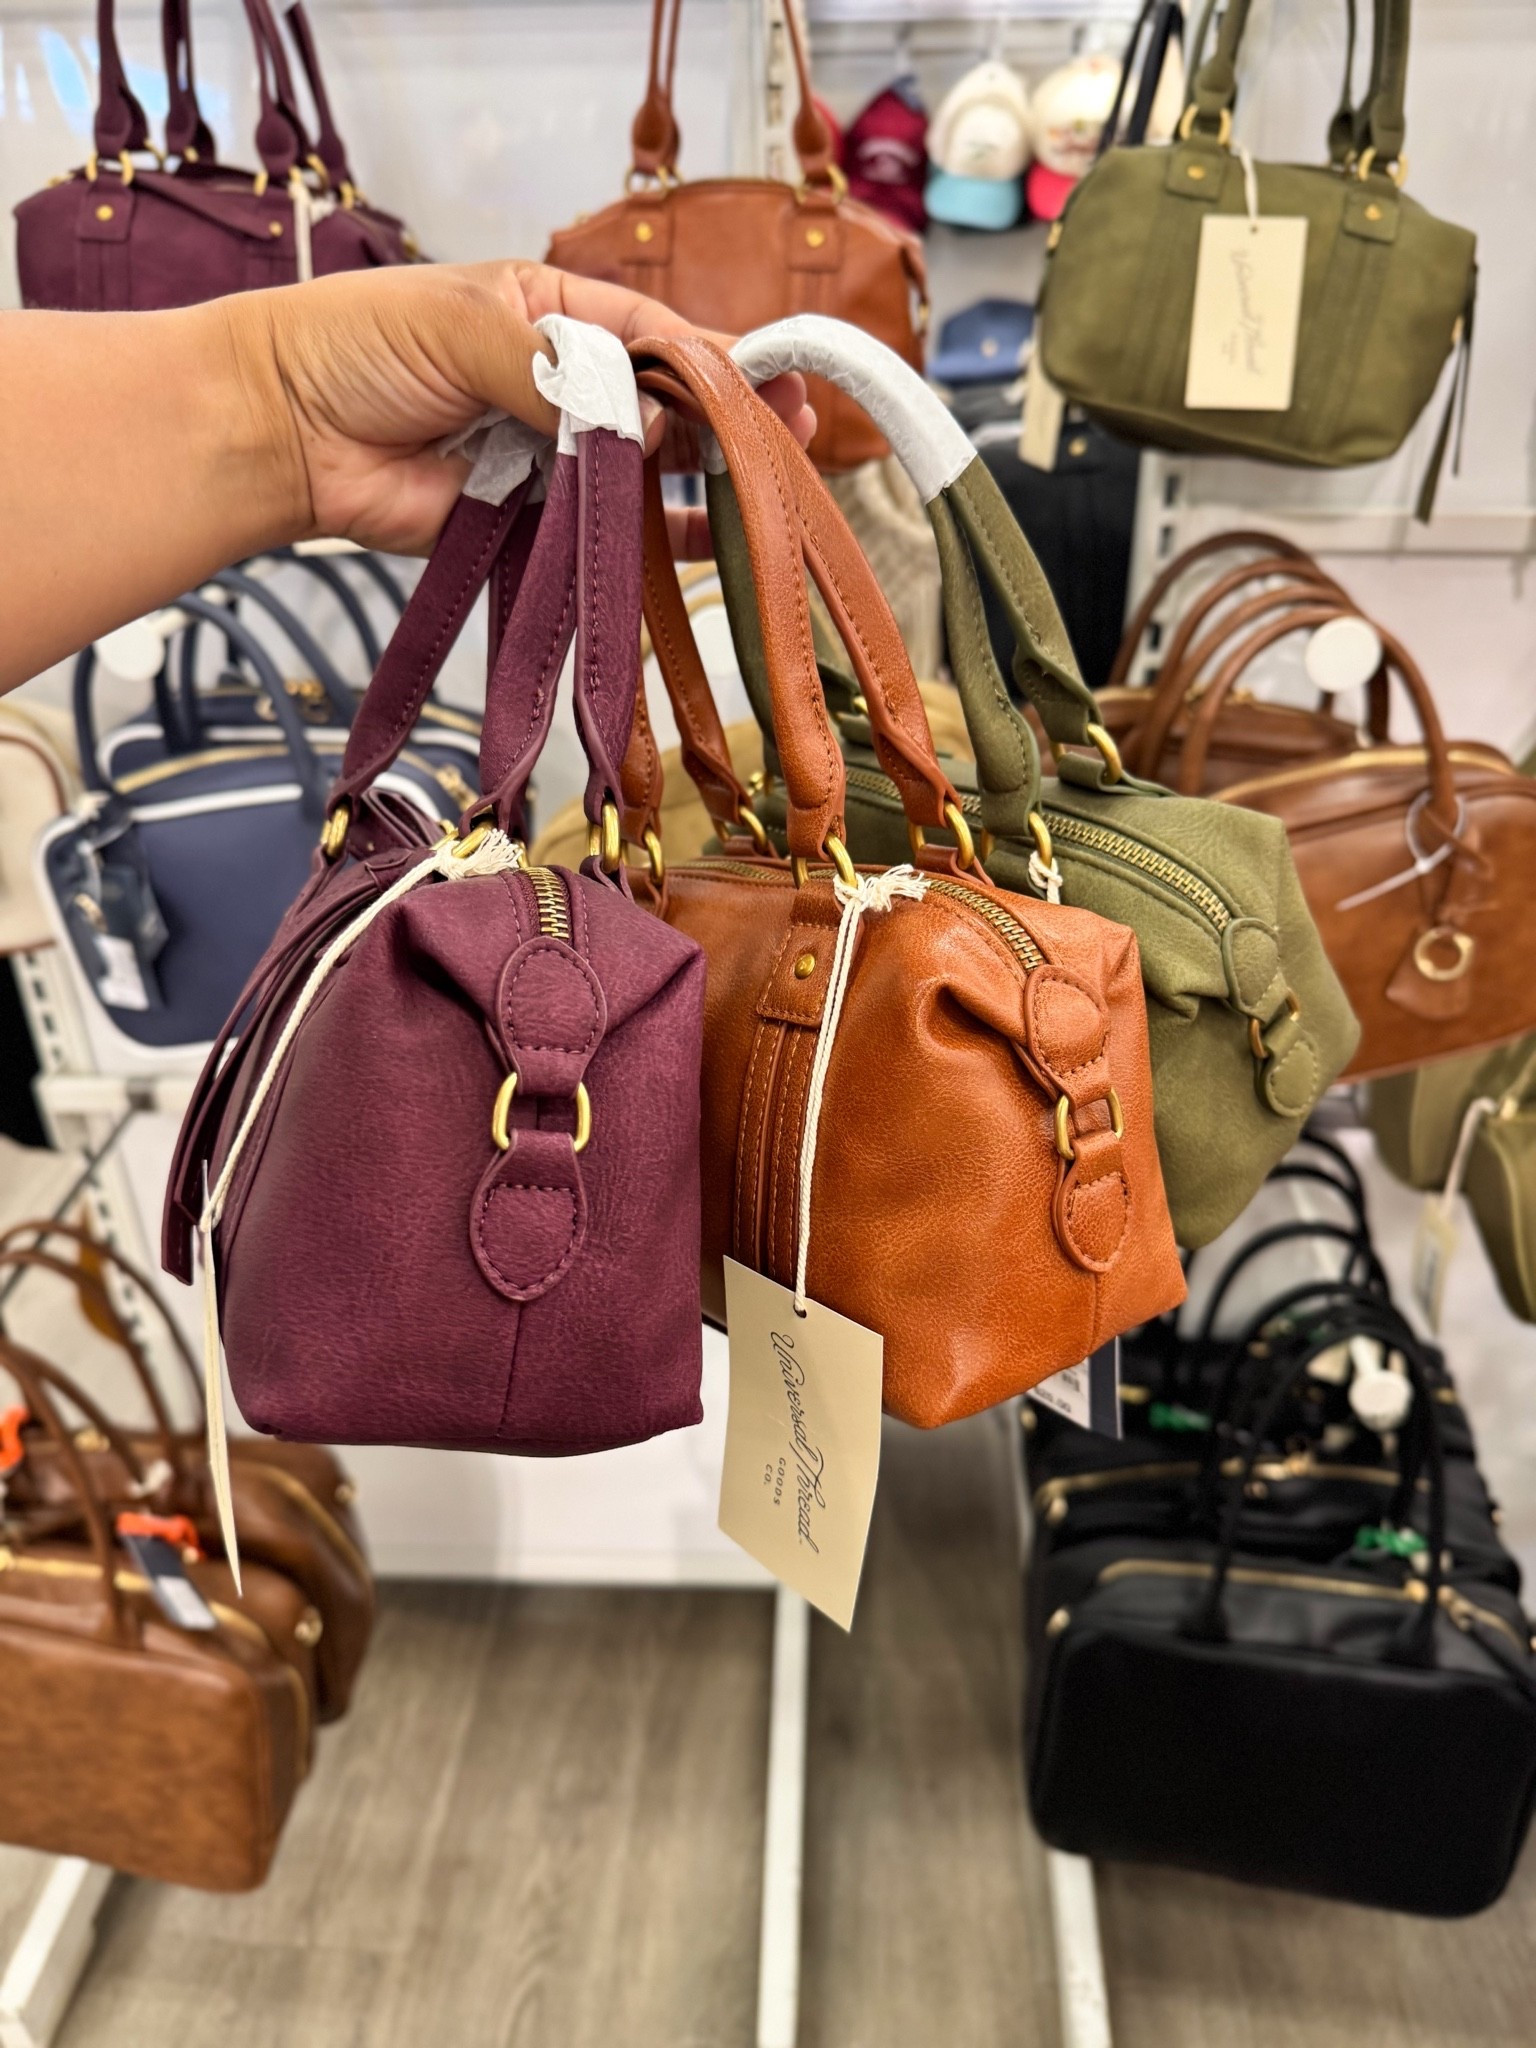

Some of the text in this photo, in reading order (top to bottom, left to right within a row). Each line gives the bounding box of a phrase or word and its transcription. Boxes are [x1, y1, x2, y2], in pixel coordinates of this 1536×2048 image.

[770, 1330, 826, 1555] Universal Thread
[773, 1456, 787, 1507] GOODS
